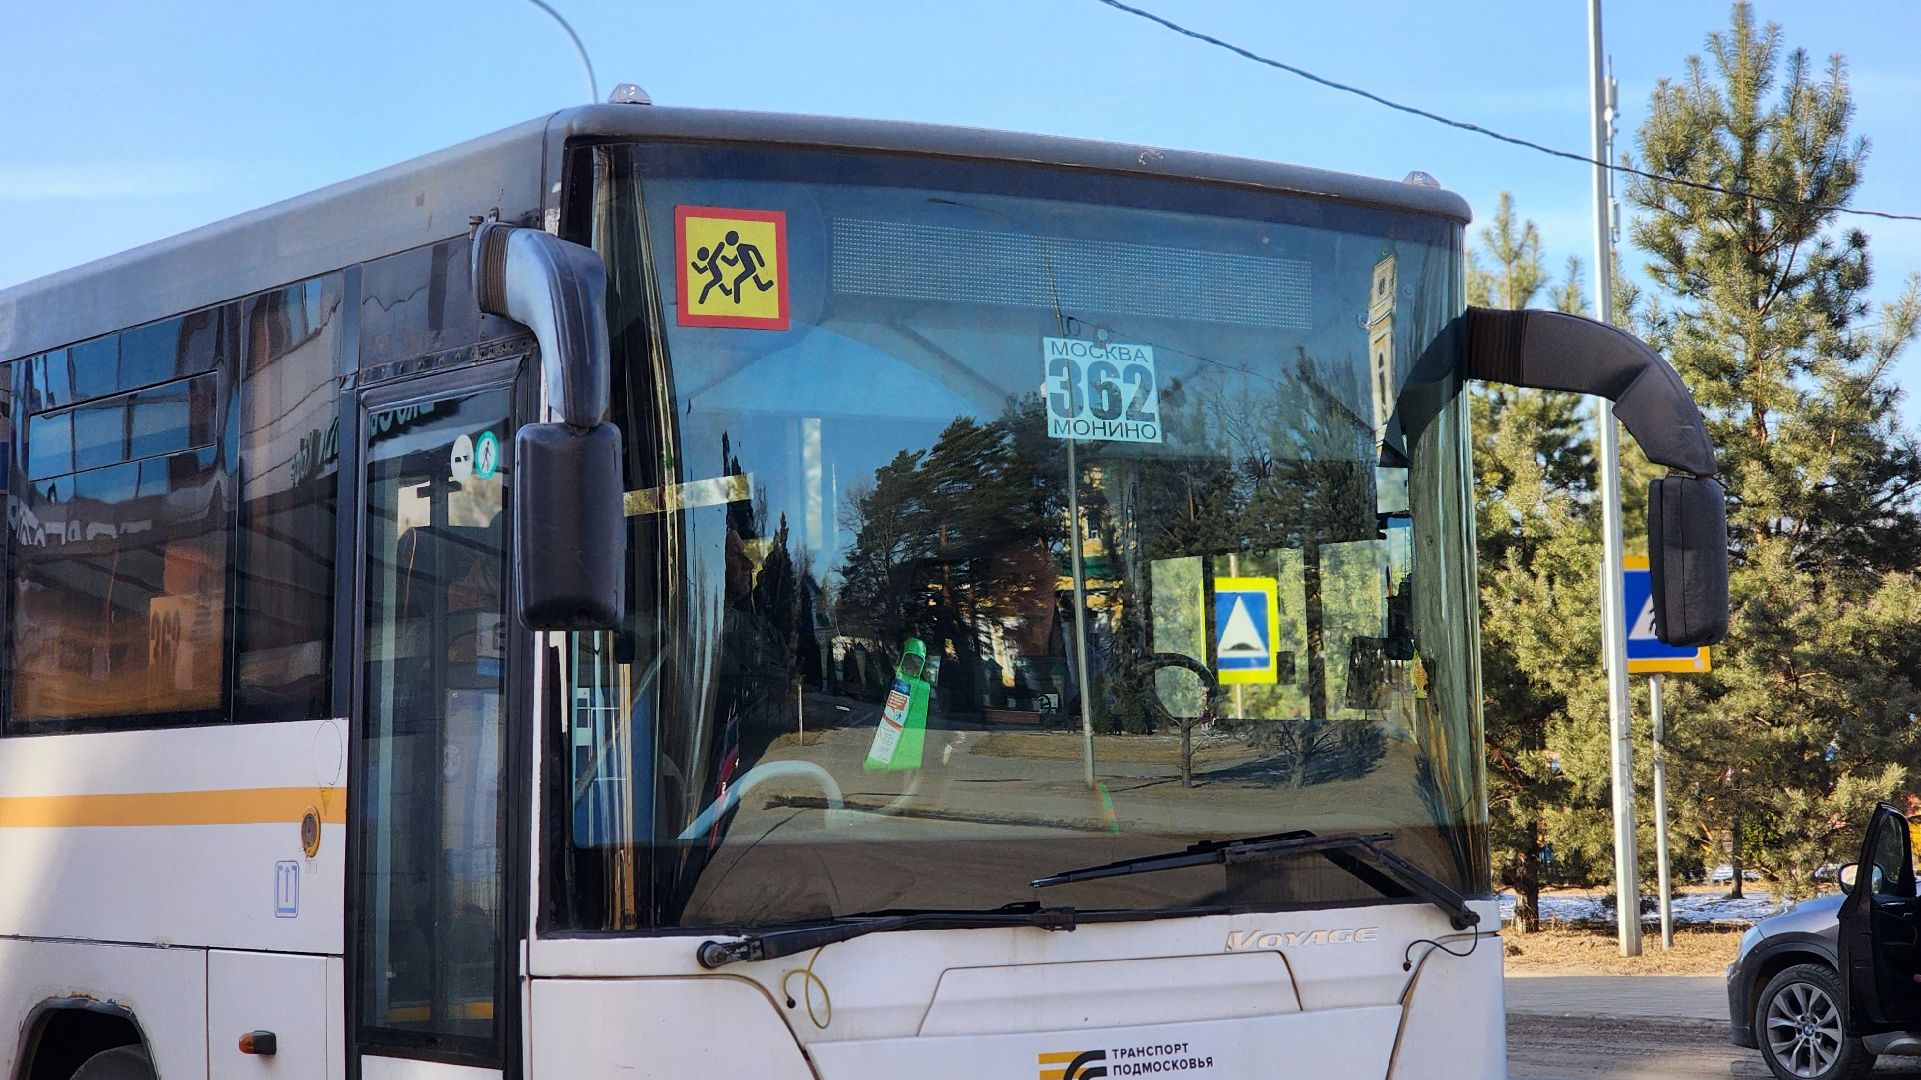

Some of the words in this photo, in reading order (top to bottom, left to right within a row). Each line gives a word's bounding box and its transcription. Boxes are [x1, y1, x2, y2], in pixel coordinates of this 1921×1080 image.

[1050, 340, 1148, 363] МОСКВА
[1048, 357, 1155, 422] 362
[1053, 418, 1157, 439] МОНИНО
[1225, 927, 1380, 952] VOYAGE
[1112, 1043, 1189, 1060] ТРАНСПОРТ
[1113, 1056, 1214, 1076] ПОДМОСКОВЬЯ
